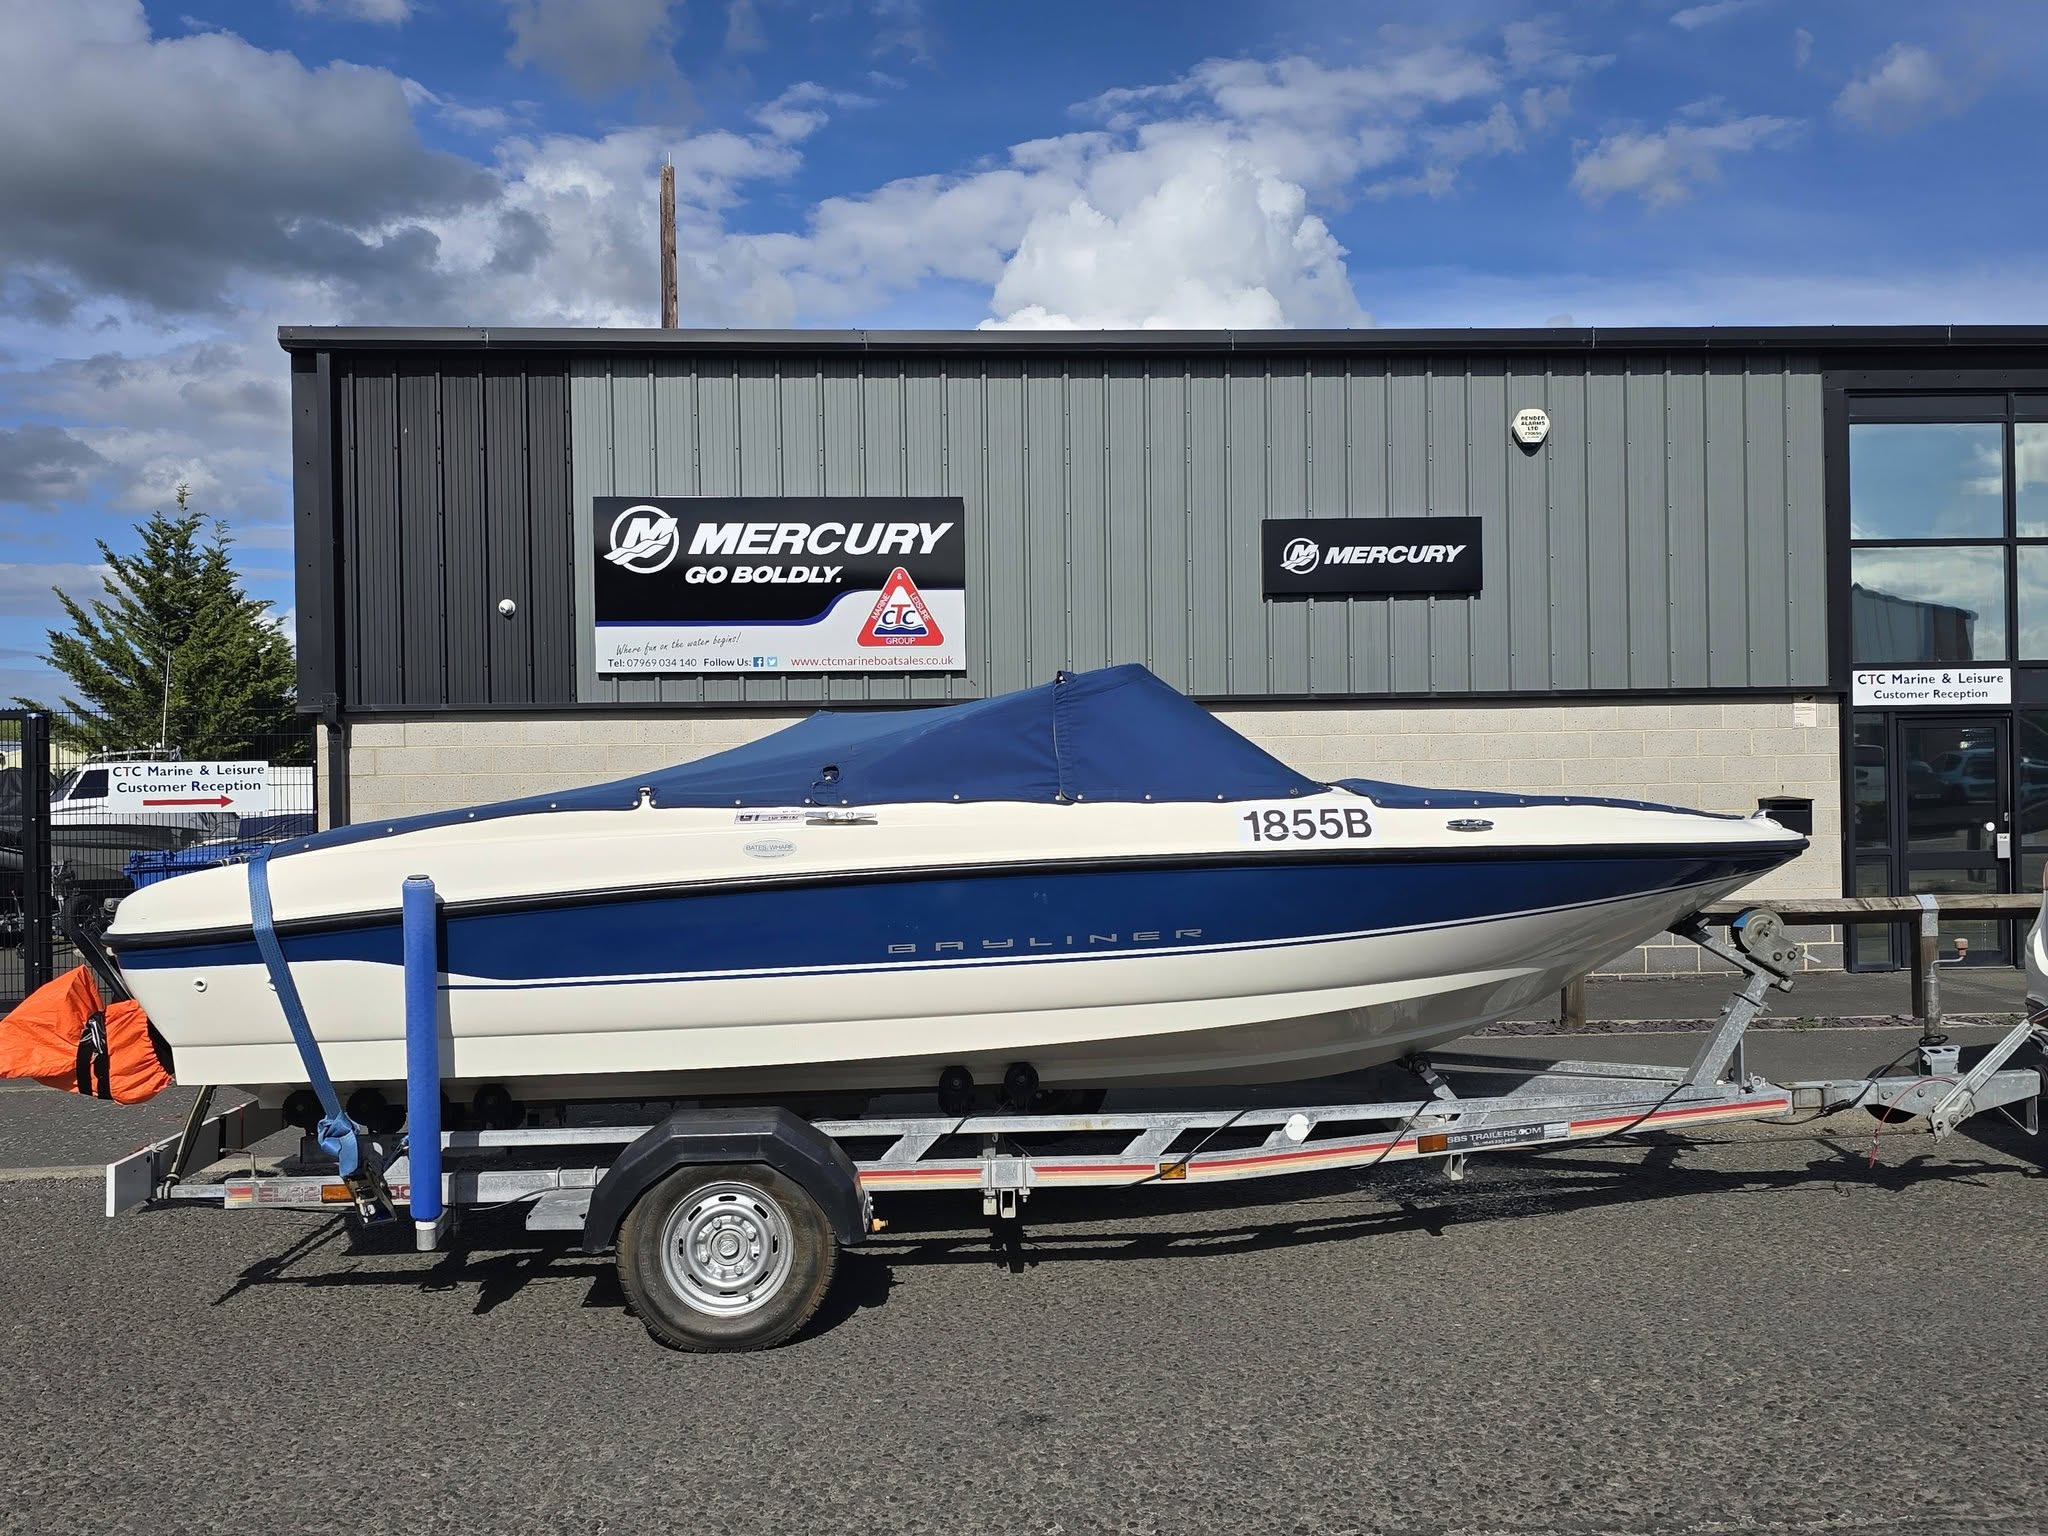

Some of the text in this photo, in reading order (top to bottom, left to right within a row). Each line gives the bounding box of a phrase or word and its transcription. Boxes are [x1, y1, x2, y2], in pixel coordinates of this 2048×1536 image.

[688, 522, 954, 555] MERCURY
[1324, 544, 1467, 565] MERCURY
[685, 566, 844, 584] GO BOLDLY.
[871, 592, 891, 621] MARINE
[882, 604, 916, 625] CTC
[910, 592, 932, 622] LEISURE
[616, 644, 642, 656] Where
[644, 642, 657, 655] fun
[671, 639, 684, 649] the
[687, 638, 710, 648] water
[713, 632, 742, 648] begins!
[608, 658, 751, 668] Tel: 07969 034 140 Follow Us:
[791, 656, 954, 667] www.ctcmarineboatsales.co.uk
[1858, 672, 2004, 685] CTC Marine & Leisure
[1874, 689, 1989, 700] Customer Reception
[112, 765, 265, 777] CTC Marine & Leisure
[116, 780, 261, 794] Customer Reception
[1243, 808, 1373, 842] 1855B
[888, 928, 1202, 954] BAYLINER
[1470, 1126, 1542, 1141] TRAILERS.COM
